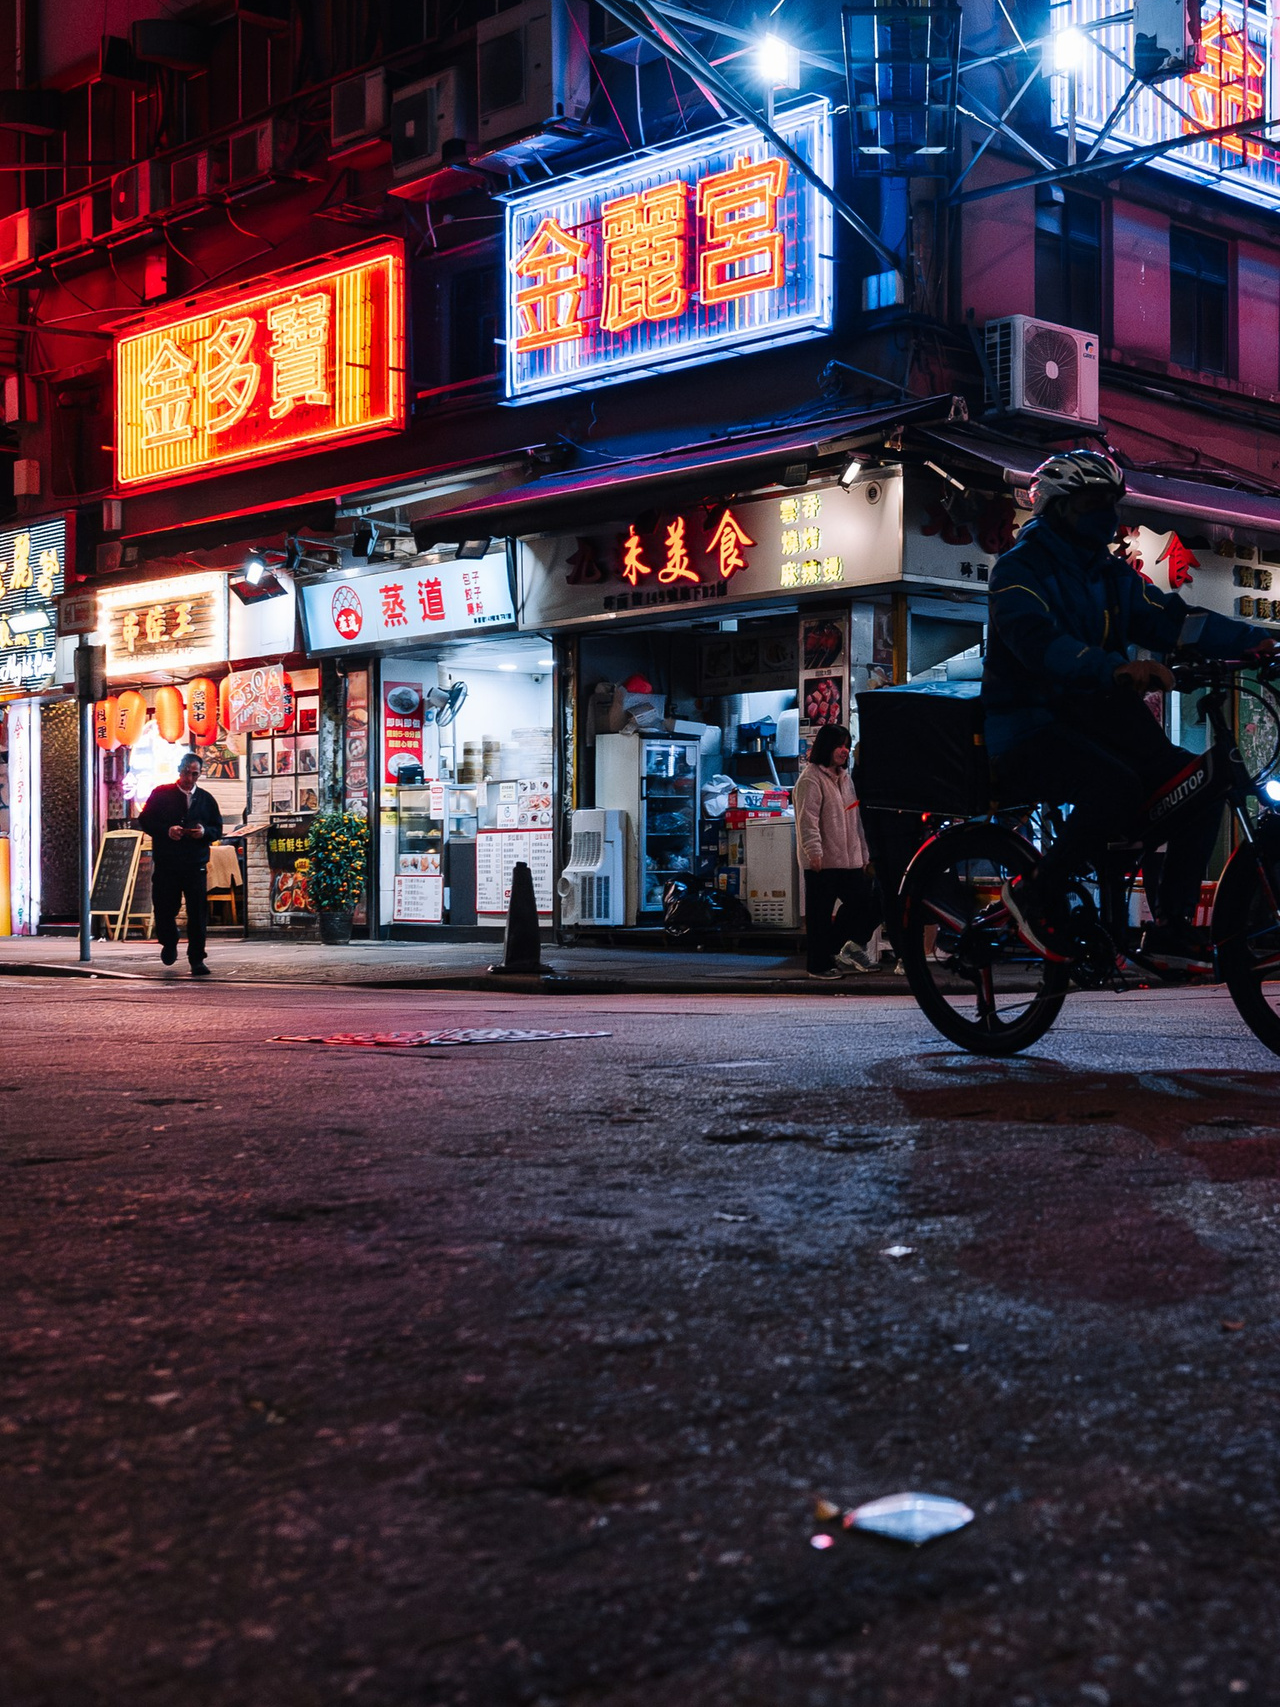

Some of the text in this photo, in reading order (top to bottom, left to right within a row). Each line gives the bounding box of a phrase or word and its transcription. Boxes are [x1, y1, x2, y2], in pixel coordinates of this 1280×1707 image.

[510, 156, 788, 353] 金麗宮
[139, 293, 332, 450] 金多寶
[379, 577, 446, 628] 蒸道
